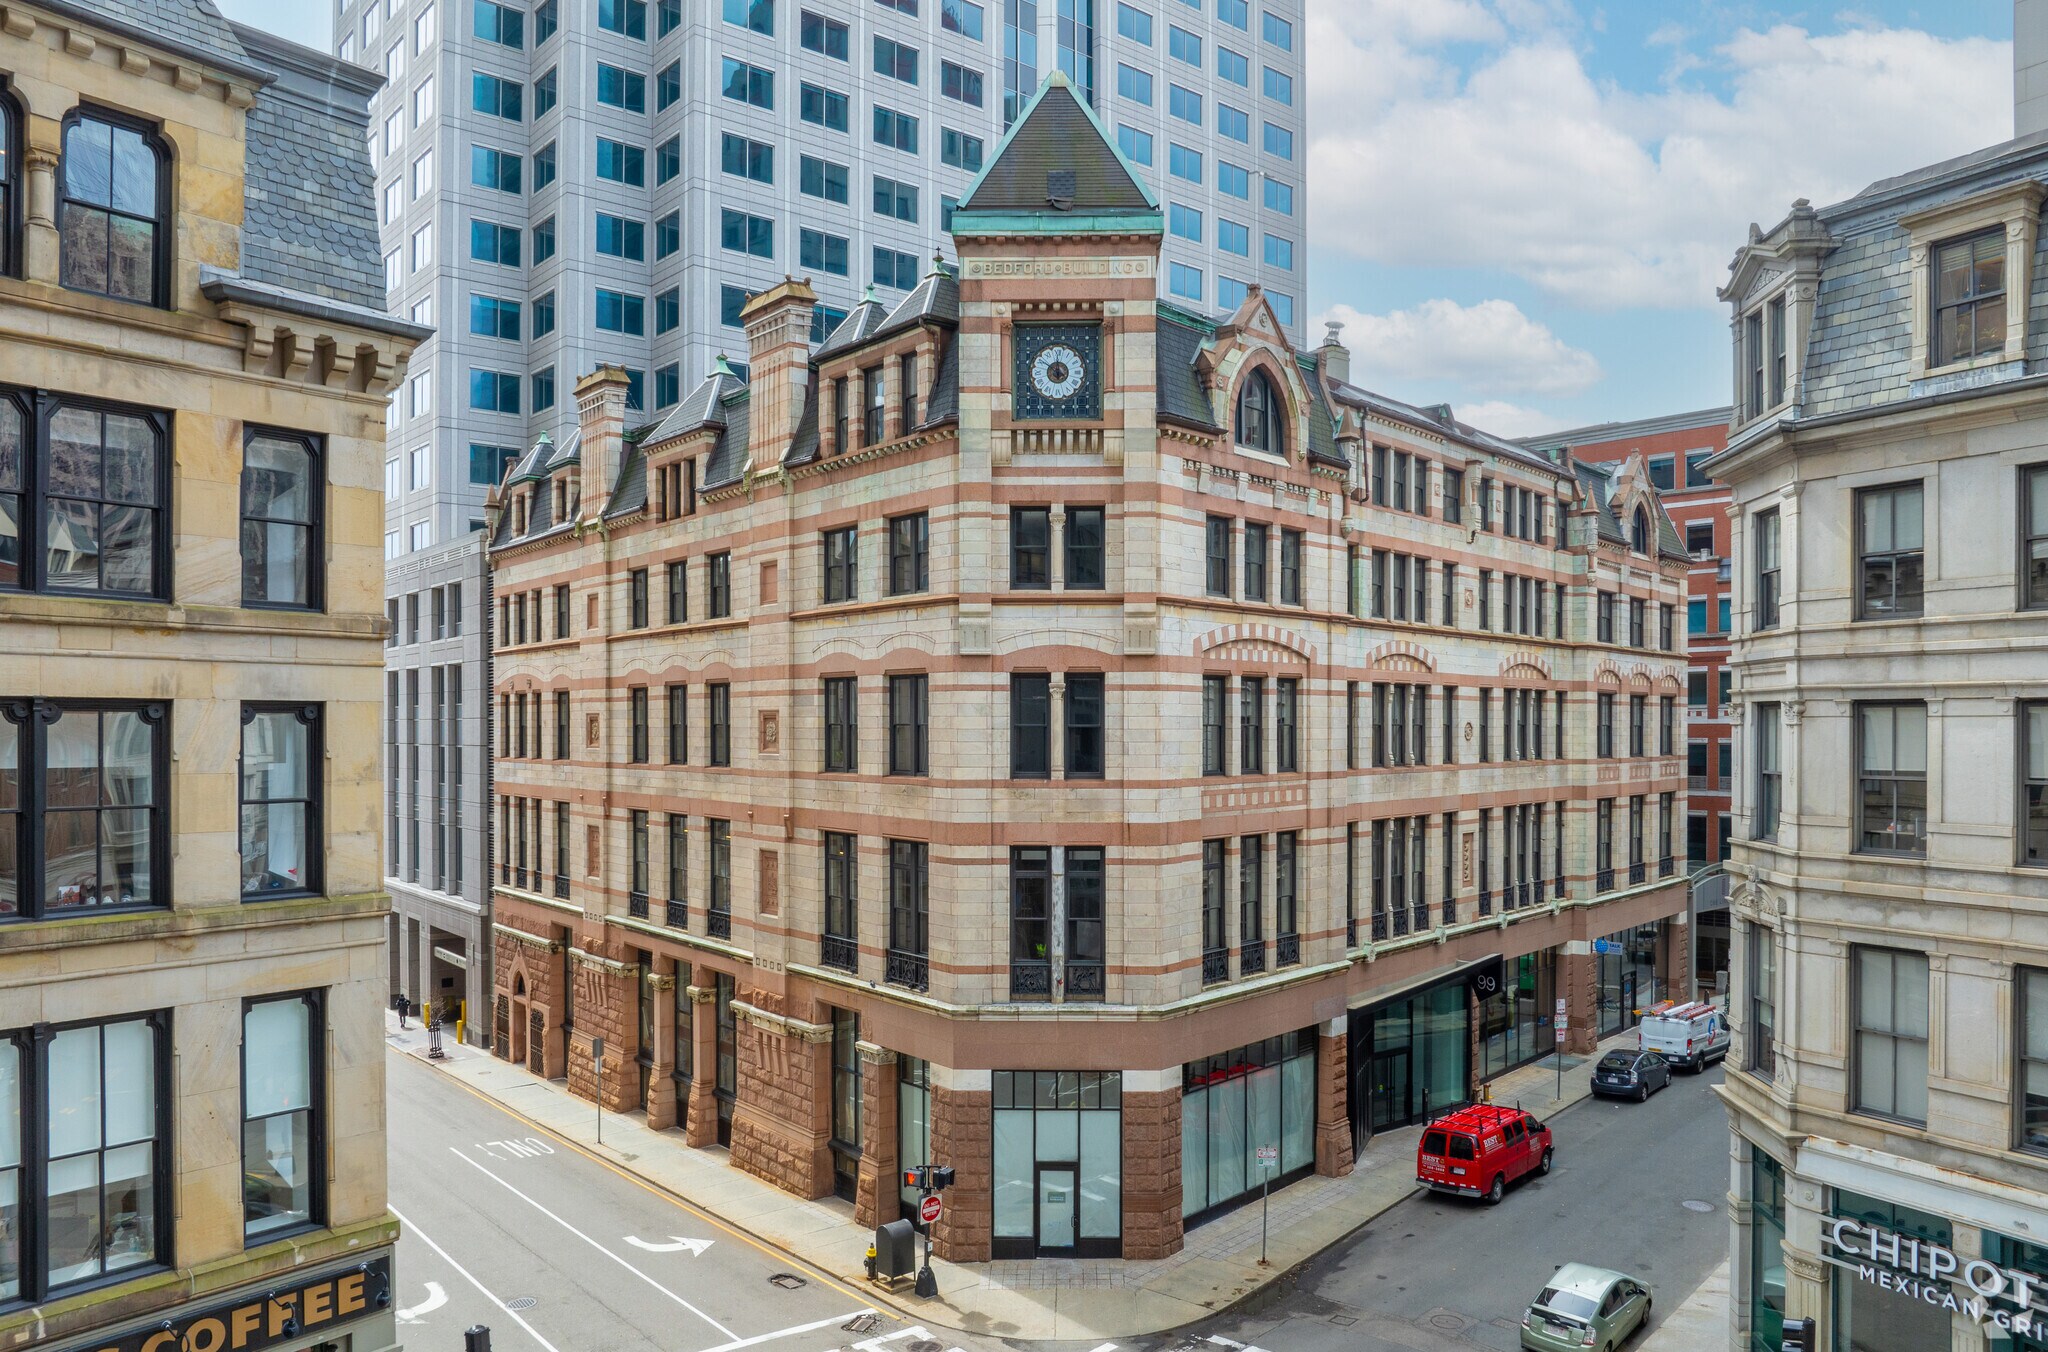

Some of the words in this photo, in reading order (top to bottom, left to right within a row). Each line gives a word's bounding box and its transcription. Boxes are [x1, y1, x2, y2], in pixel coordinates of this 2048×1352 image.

[983, 262, 1054, 275] BEDFORD
[1063, 262, 1133, 275] BUILDING
[1477, 975, 1496, 992] 99
[1483, 1135, 1498, 1147] BEST
[1833, 1219, 2041, 1310] CHIPOT
[140, 1273, 366, 1352] COFFEE
[1859, 1264, 1982, 1319] MEXICAN
[1993, 1309, 2045, 1342] GRI
